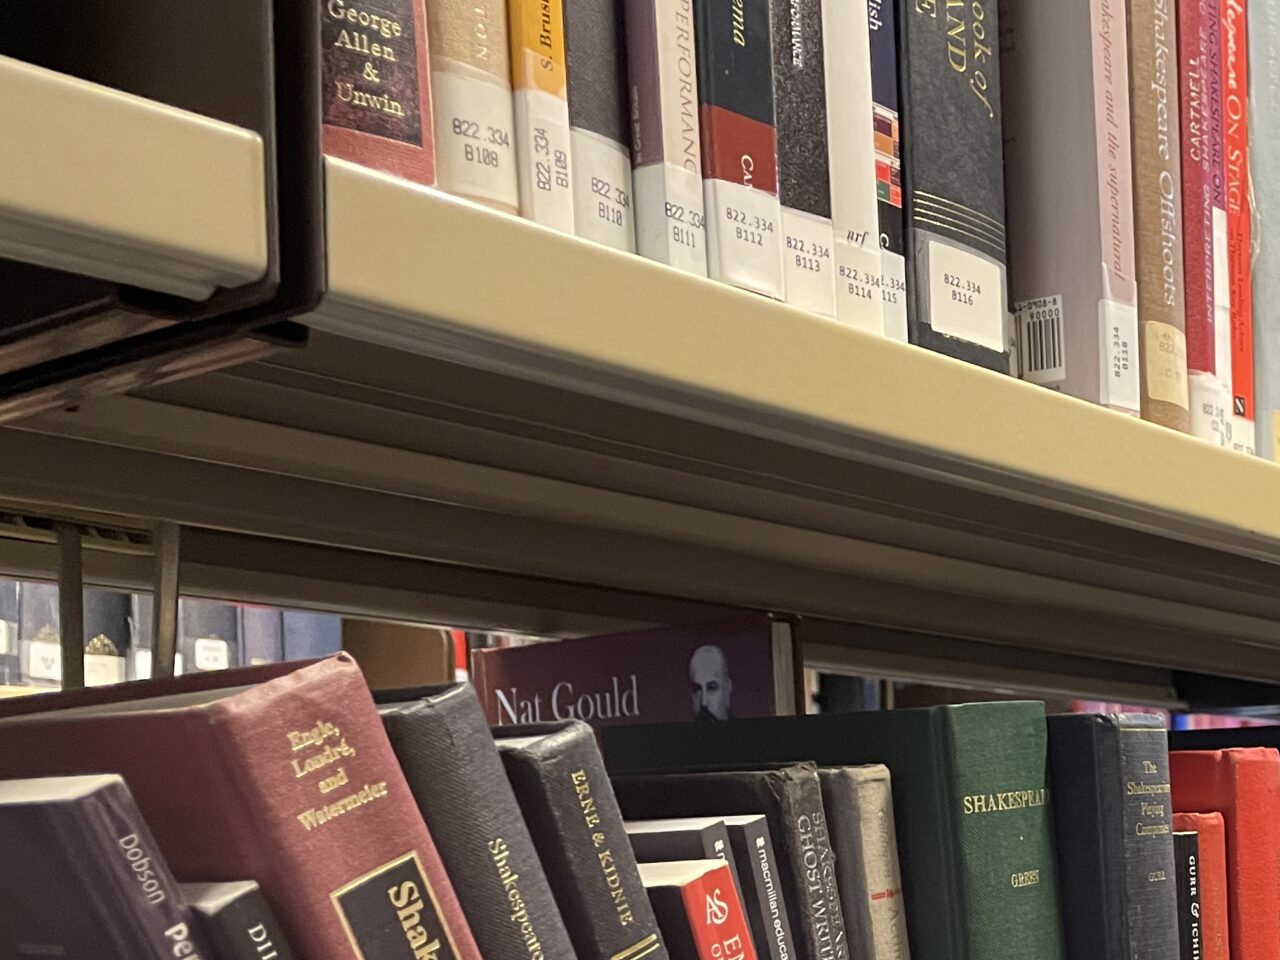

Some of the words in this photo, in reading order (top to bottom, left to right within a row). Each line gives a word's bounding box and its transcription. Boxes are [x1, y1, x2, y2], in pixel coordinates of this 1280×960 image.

[327, 0, 402, 38] George
[334, 29, 396, 62] Allen
[362, 62, 380, 83] &
[334, 81, 405, 117] Unwin
[970, 70, 994, 118] of
[1105, 90, 1119, 128] and
[1188, 57, 1201, 162] CARTMELL
[1210, 48, 1222, 167] SHAKESPEARE
[452, 118, 510, 147] 822.334
[1226, 95, 1243, 139] ON
[534, 127, 551, 192] 822.334
[1107, 132, 1120, 160] the
[1227, 145, 1242, 217] STAGE
[726, 207, 774, 233] 822.334
[736, 227, 764, 246] B112
[1107, 164, 1126, 282] supernatural
[1159, 170, 1177, 306] Offshoots
[786, 236, 830, 259] 822.334
[795, 254, 821, 272] B113
[839, 266, 880, 288] 822.334
[848, 283, 873, 300] B114
[944, 273, 981, 295] 822.334
[952, 290, 974, 306] B116
[1030, 308, 1061, 321] 90000
[496, 687, 542, 725] Nat
[550, 674, 640, 722] Gould
[318, 767, 350, 795] and
[571, 768, 600, 828] ERNE
[297, 779, 389, 831] Watermeier
[592, 831, 605, 847] &
[796, 813, 822, 890] GHOST
[118, 832, 167, 906] Dobson
[598, 849, 634, 927] KIDNIE
[758, 847, 780, 919] macmillan
